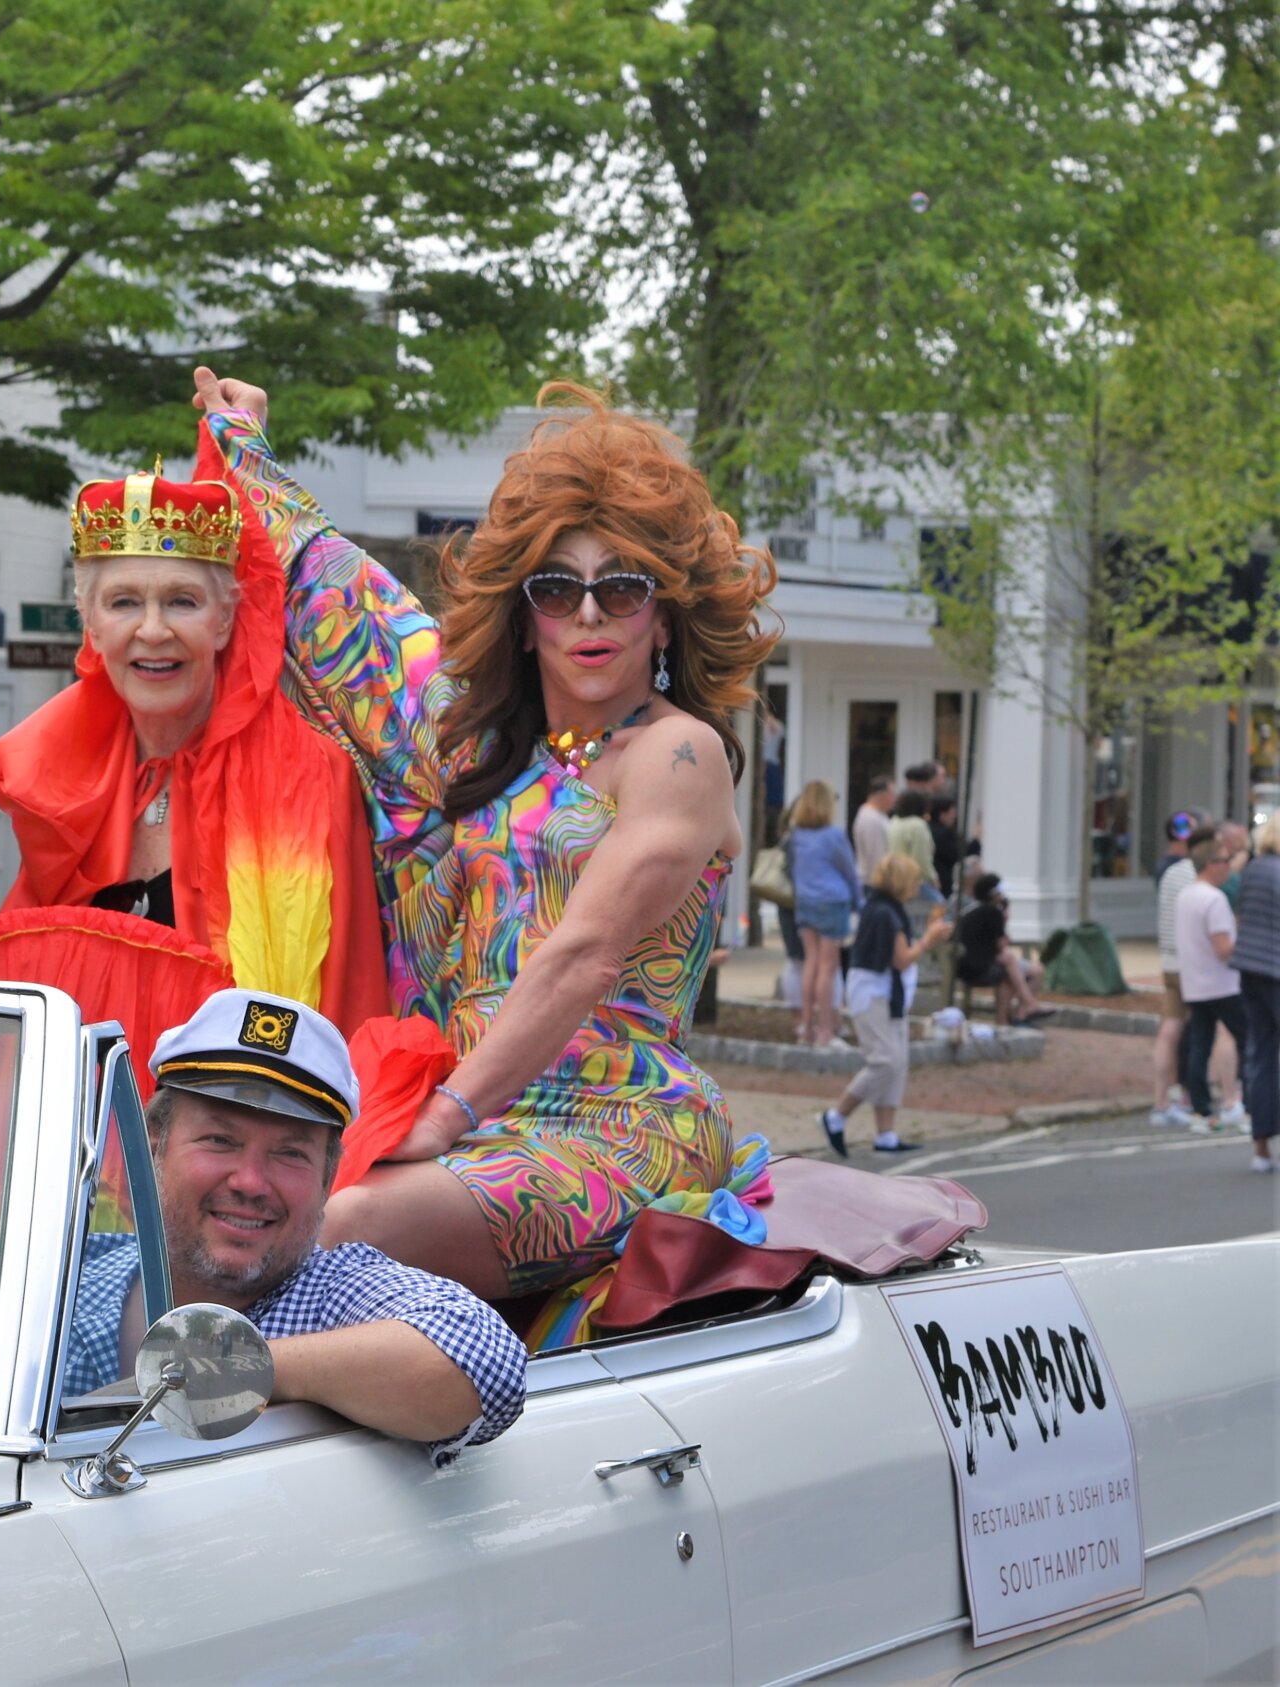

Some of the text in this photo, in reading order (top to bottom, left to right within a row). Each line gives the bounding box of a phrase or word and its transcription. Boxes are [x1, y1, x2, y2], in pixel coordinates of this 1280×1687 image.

[914, 1321, 1106, 1477] BAMBOO
[972, 1477, 1131, 1537] RESTAURANT & SUSHI BAR
[999, 1537, 1120, 1597] SOUTHAMPTON
